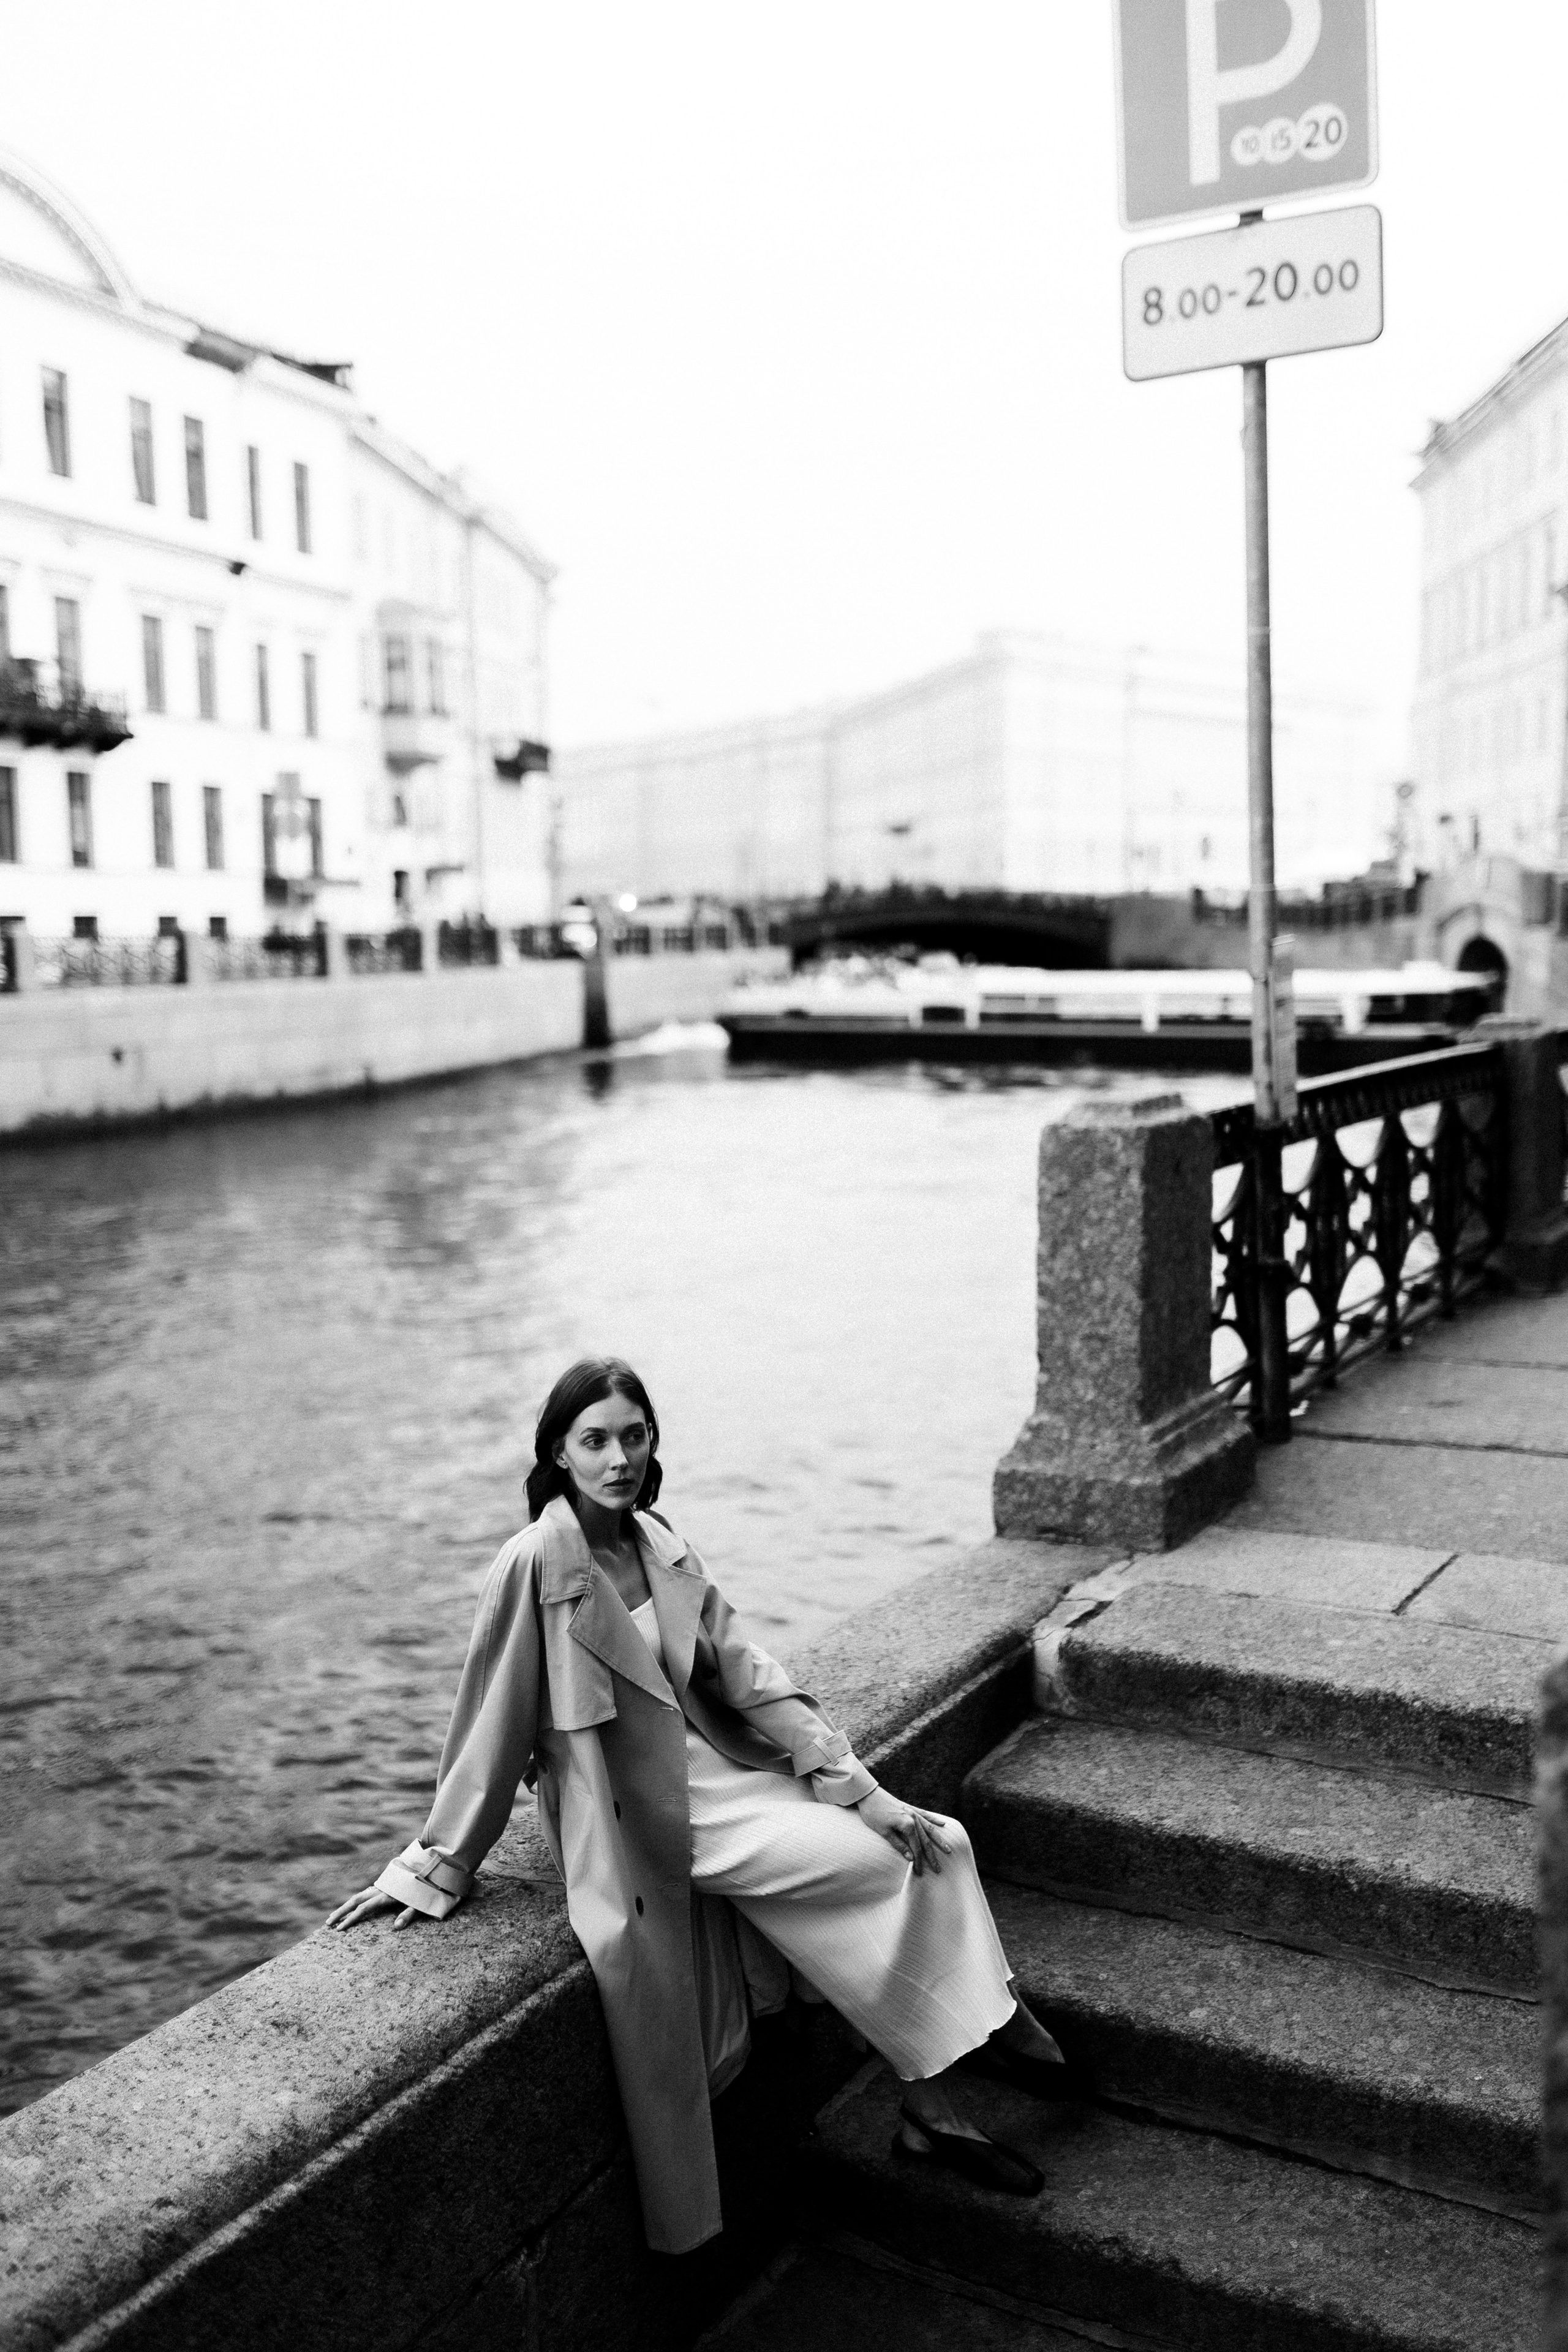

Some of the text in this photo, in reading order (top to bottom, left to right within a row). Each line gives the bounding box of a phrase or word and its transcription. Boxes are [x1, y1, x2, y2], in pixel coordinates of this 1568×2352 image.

[1185, 0, 1322, 184] P
[1271, 126, 1292, 151] 15
[1303, 116, 1342, 149] 20
